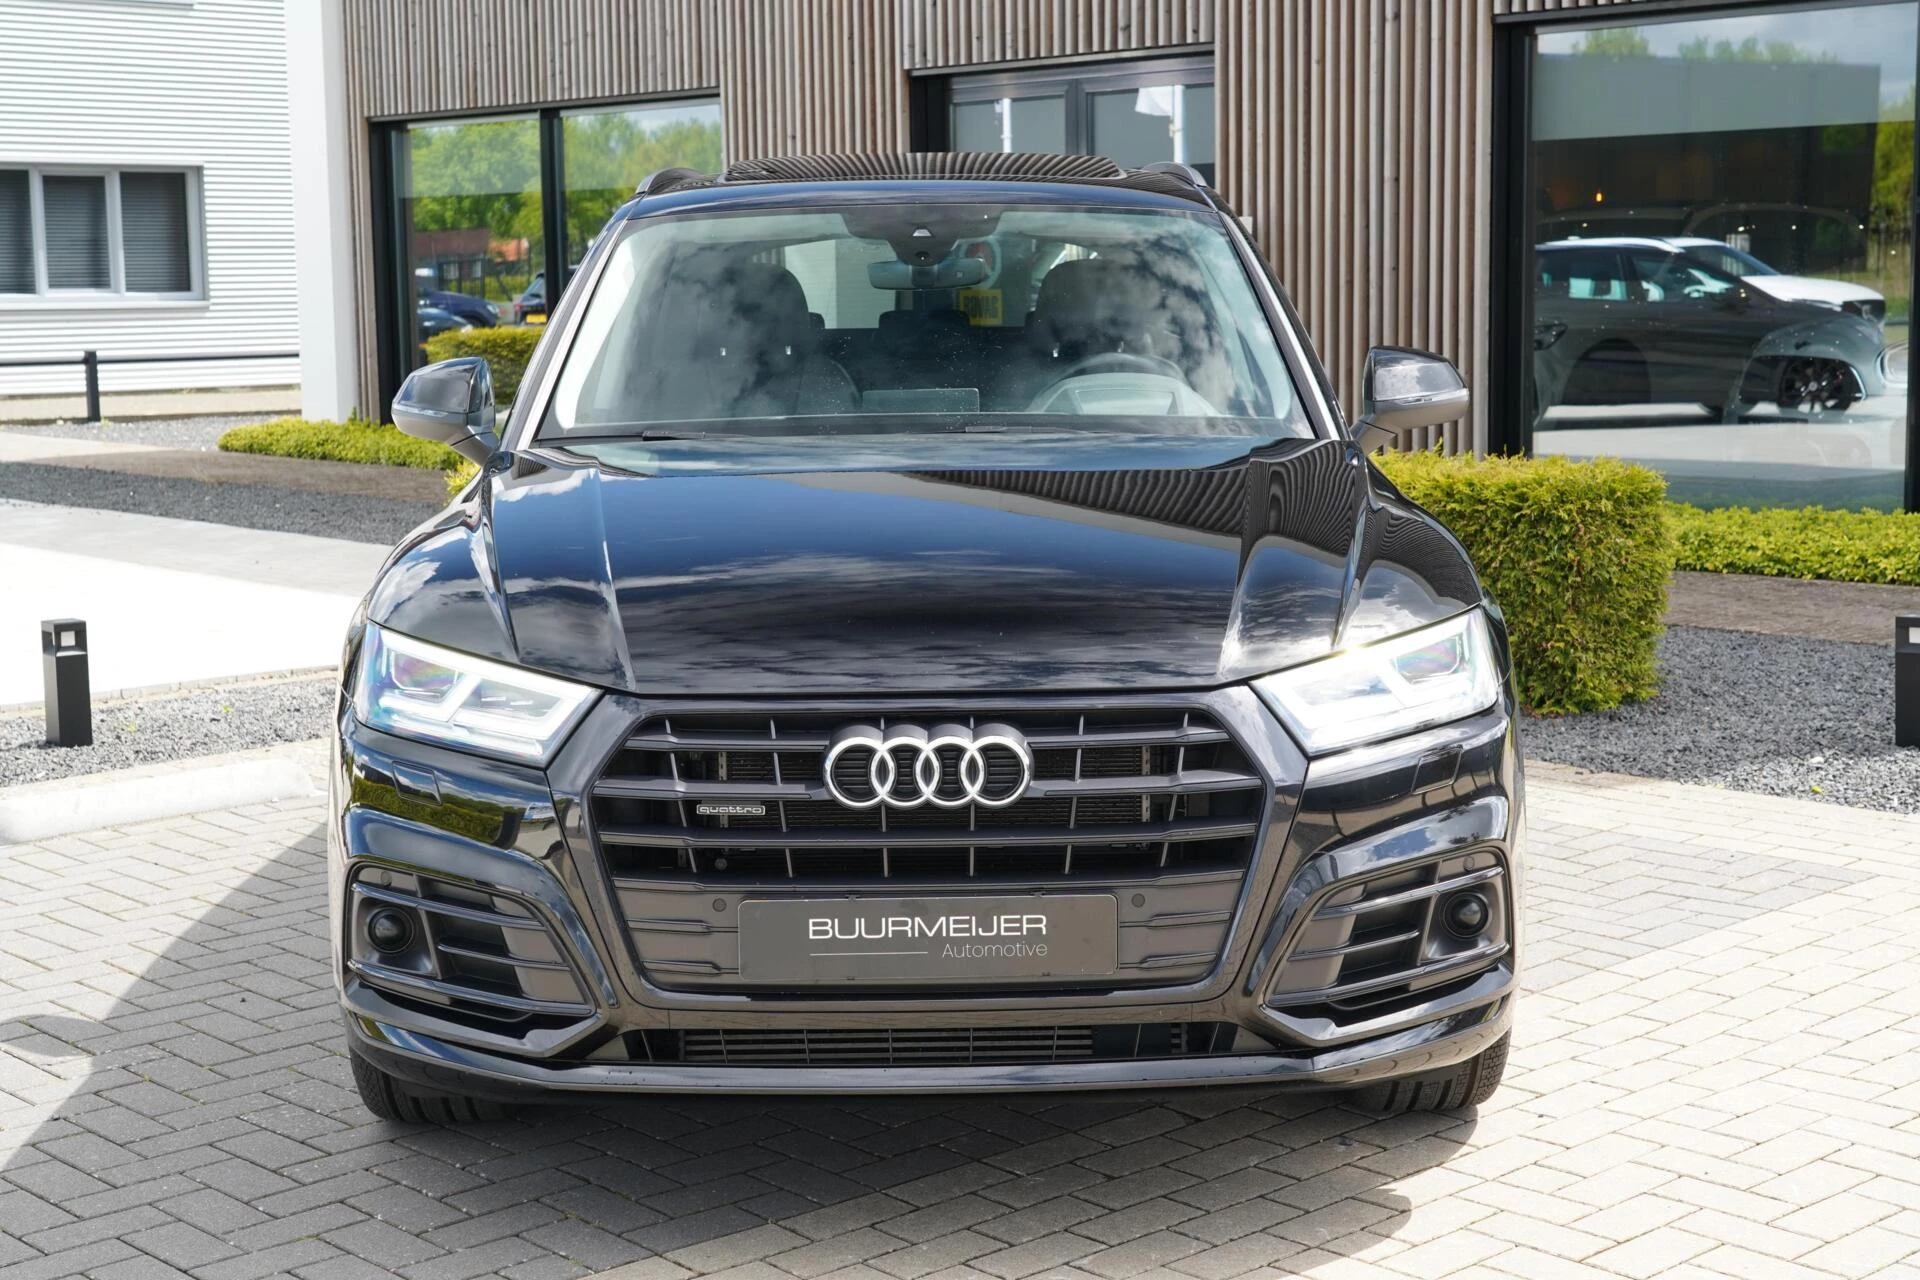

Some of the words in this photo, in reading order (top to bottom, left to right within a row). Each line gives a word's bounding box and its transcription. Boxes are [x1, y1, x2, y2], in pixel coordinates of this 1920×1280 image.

[699, 806, 762, 814] quattro
[808, 914, 1047, 940] BUURMEIJER
[942, 941, 1048, 959] Automotive
